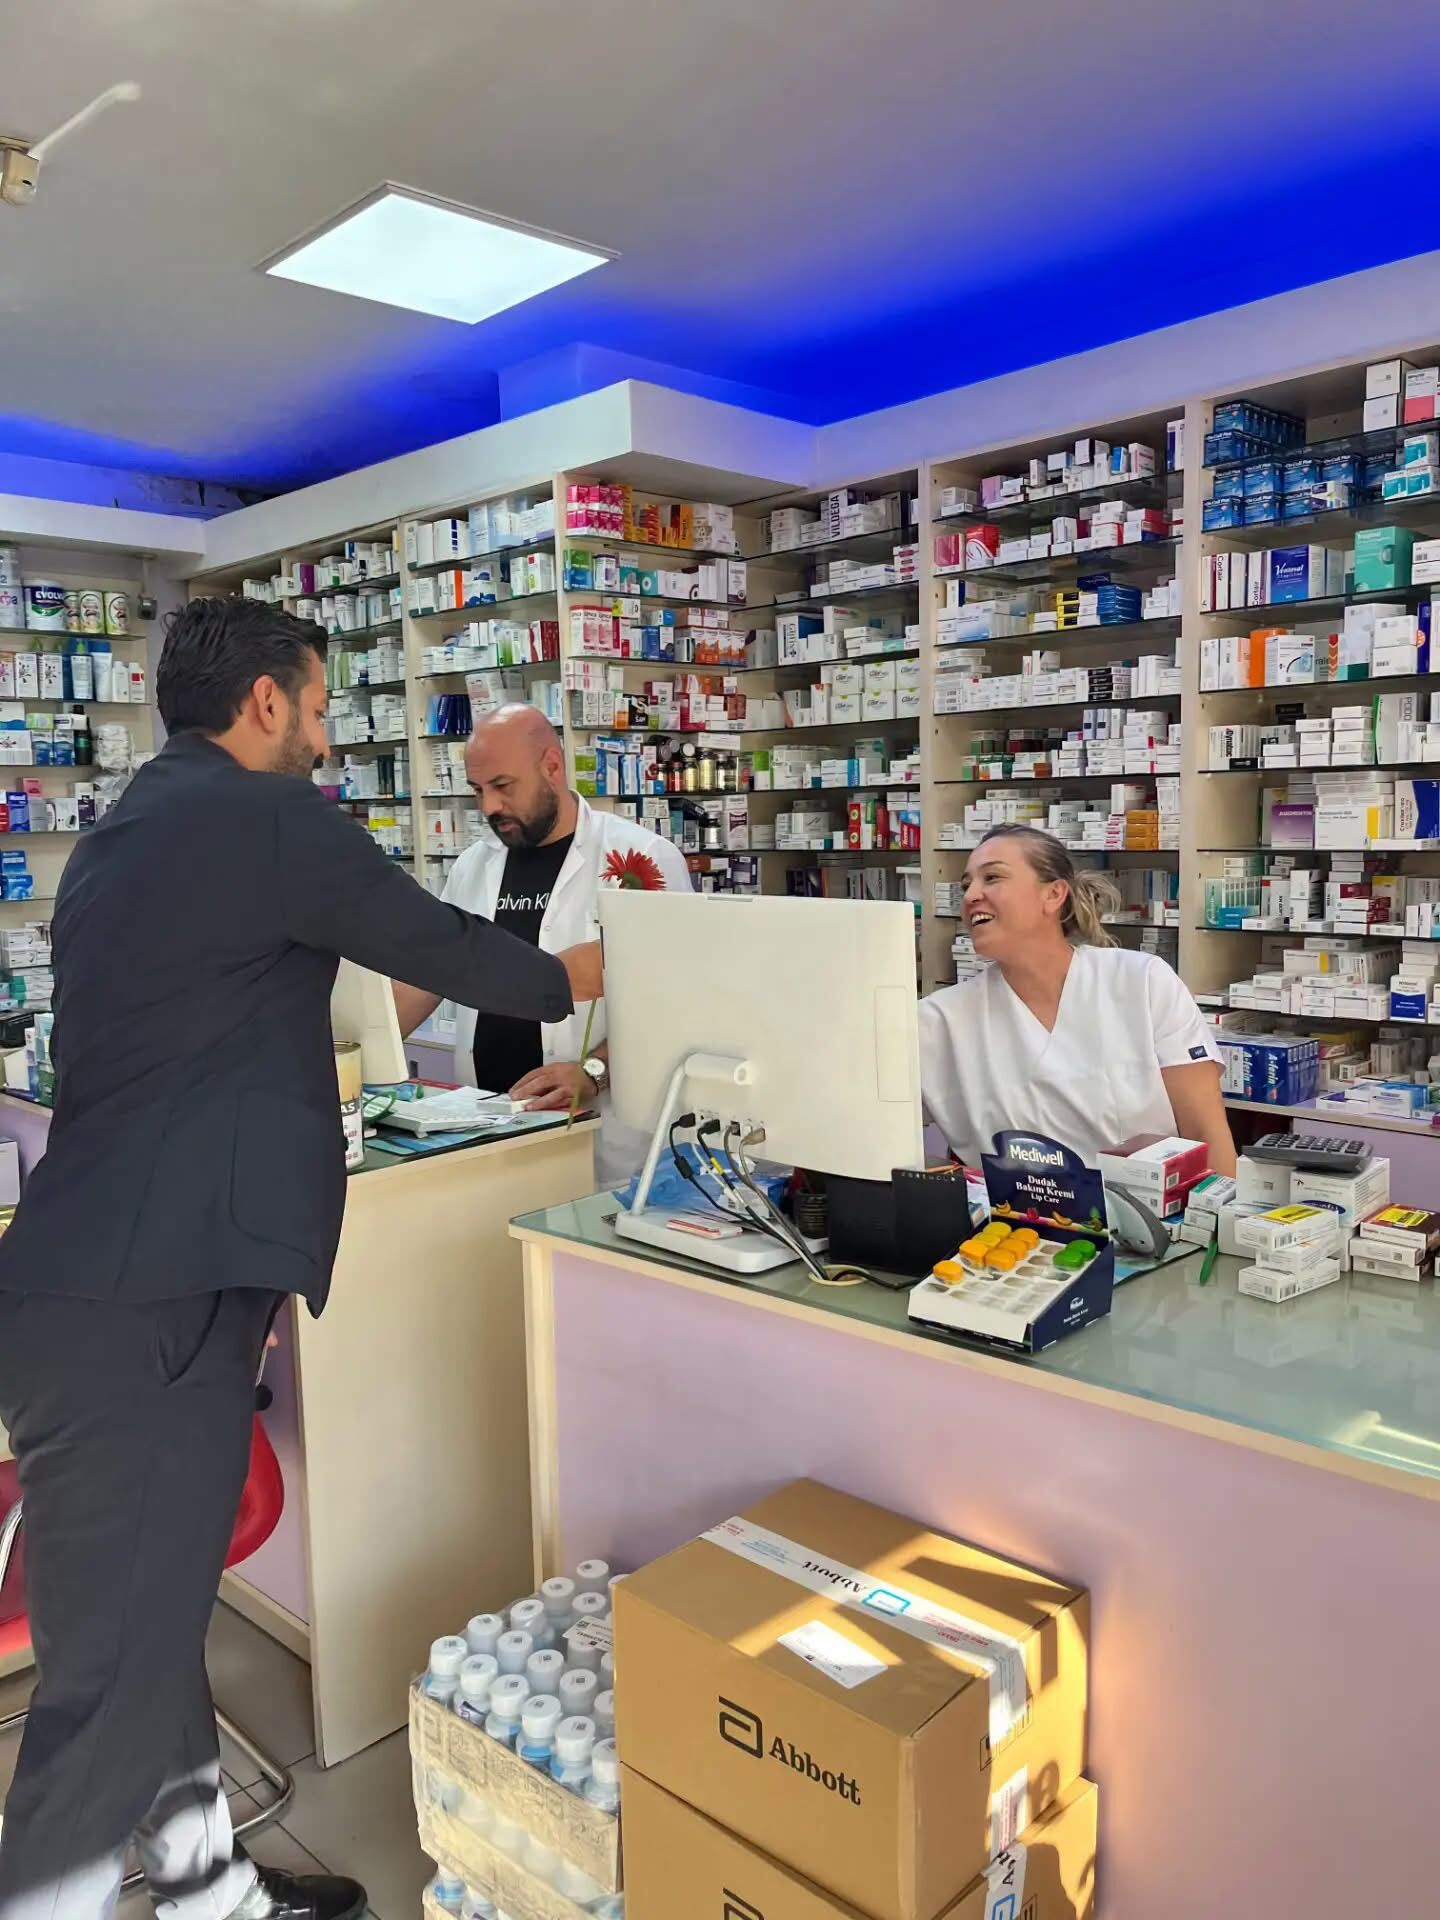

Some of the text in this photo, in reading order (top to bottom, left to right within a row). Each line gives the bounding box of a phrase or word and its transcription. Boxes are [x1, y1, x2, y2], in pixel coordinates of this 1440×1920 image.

[831, 494, 841, 539] VILDEGA
[496, 892, 531, 910] alvin
[1009, 1144, 1064, 1167] Mediwell
[1016, 1182, 1075, 1199] Bakım Kremi
[1027, 1175, 1057, 1188] Dudak
[1031, 1193, 1060, 1204] Lip Care
[801, 1560, 866, 1593] Abbott
[768, 1736, 861, 1806] Abbott
